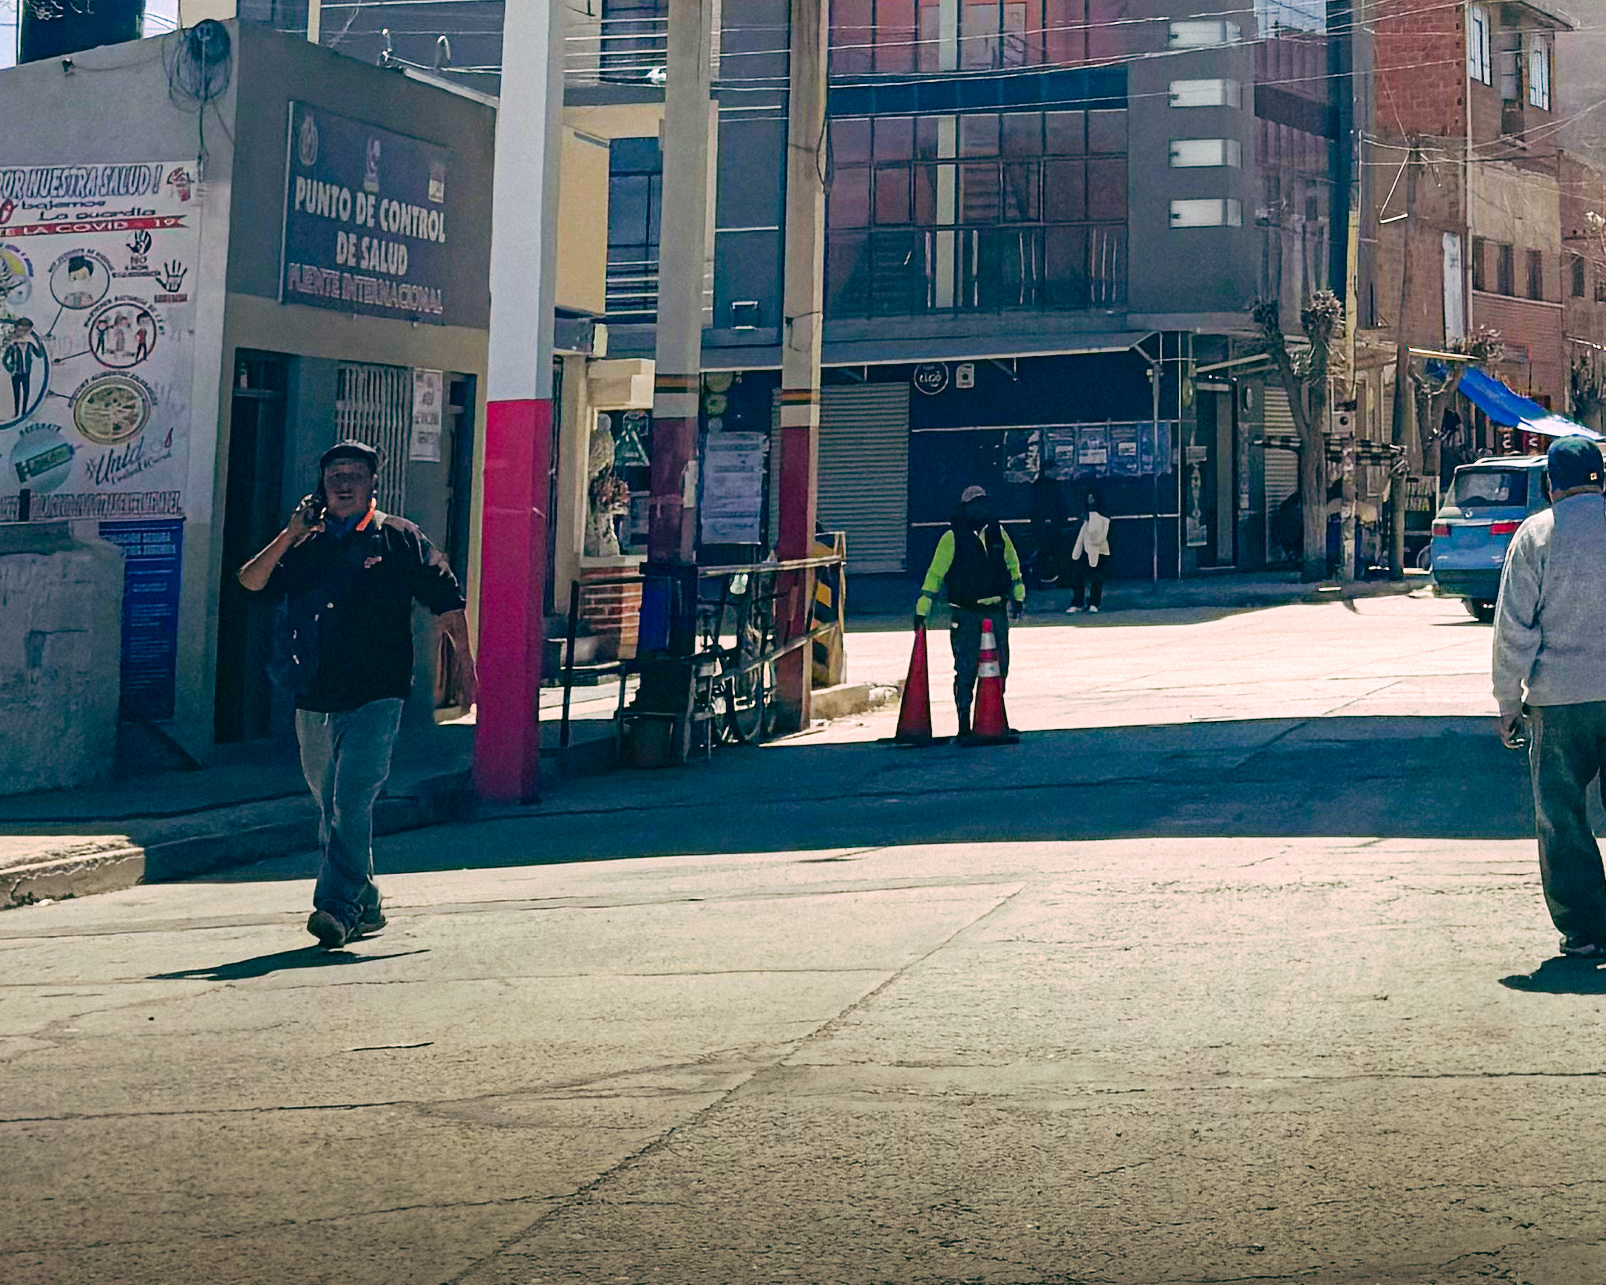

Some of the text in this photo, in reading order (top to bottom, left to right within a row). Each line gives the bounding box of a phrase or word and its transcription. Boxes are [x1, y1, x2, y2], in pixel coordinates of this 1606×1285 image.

[26, 166, 98, 199] NUESTRA
[23, 226, 49, 235] LA
[55, 221, 129, 233] COVID
[294, 175, 446, 244] PUNTO DE CONTROL
[335, 230, 409, 276] DE SALUD
